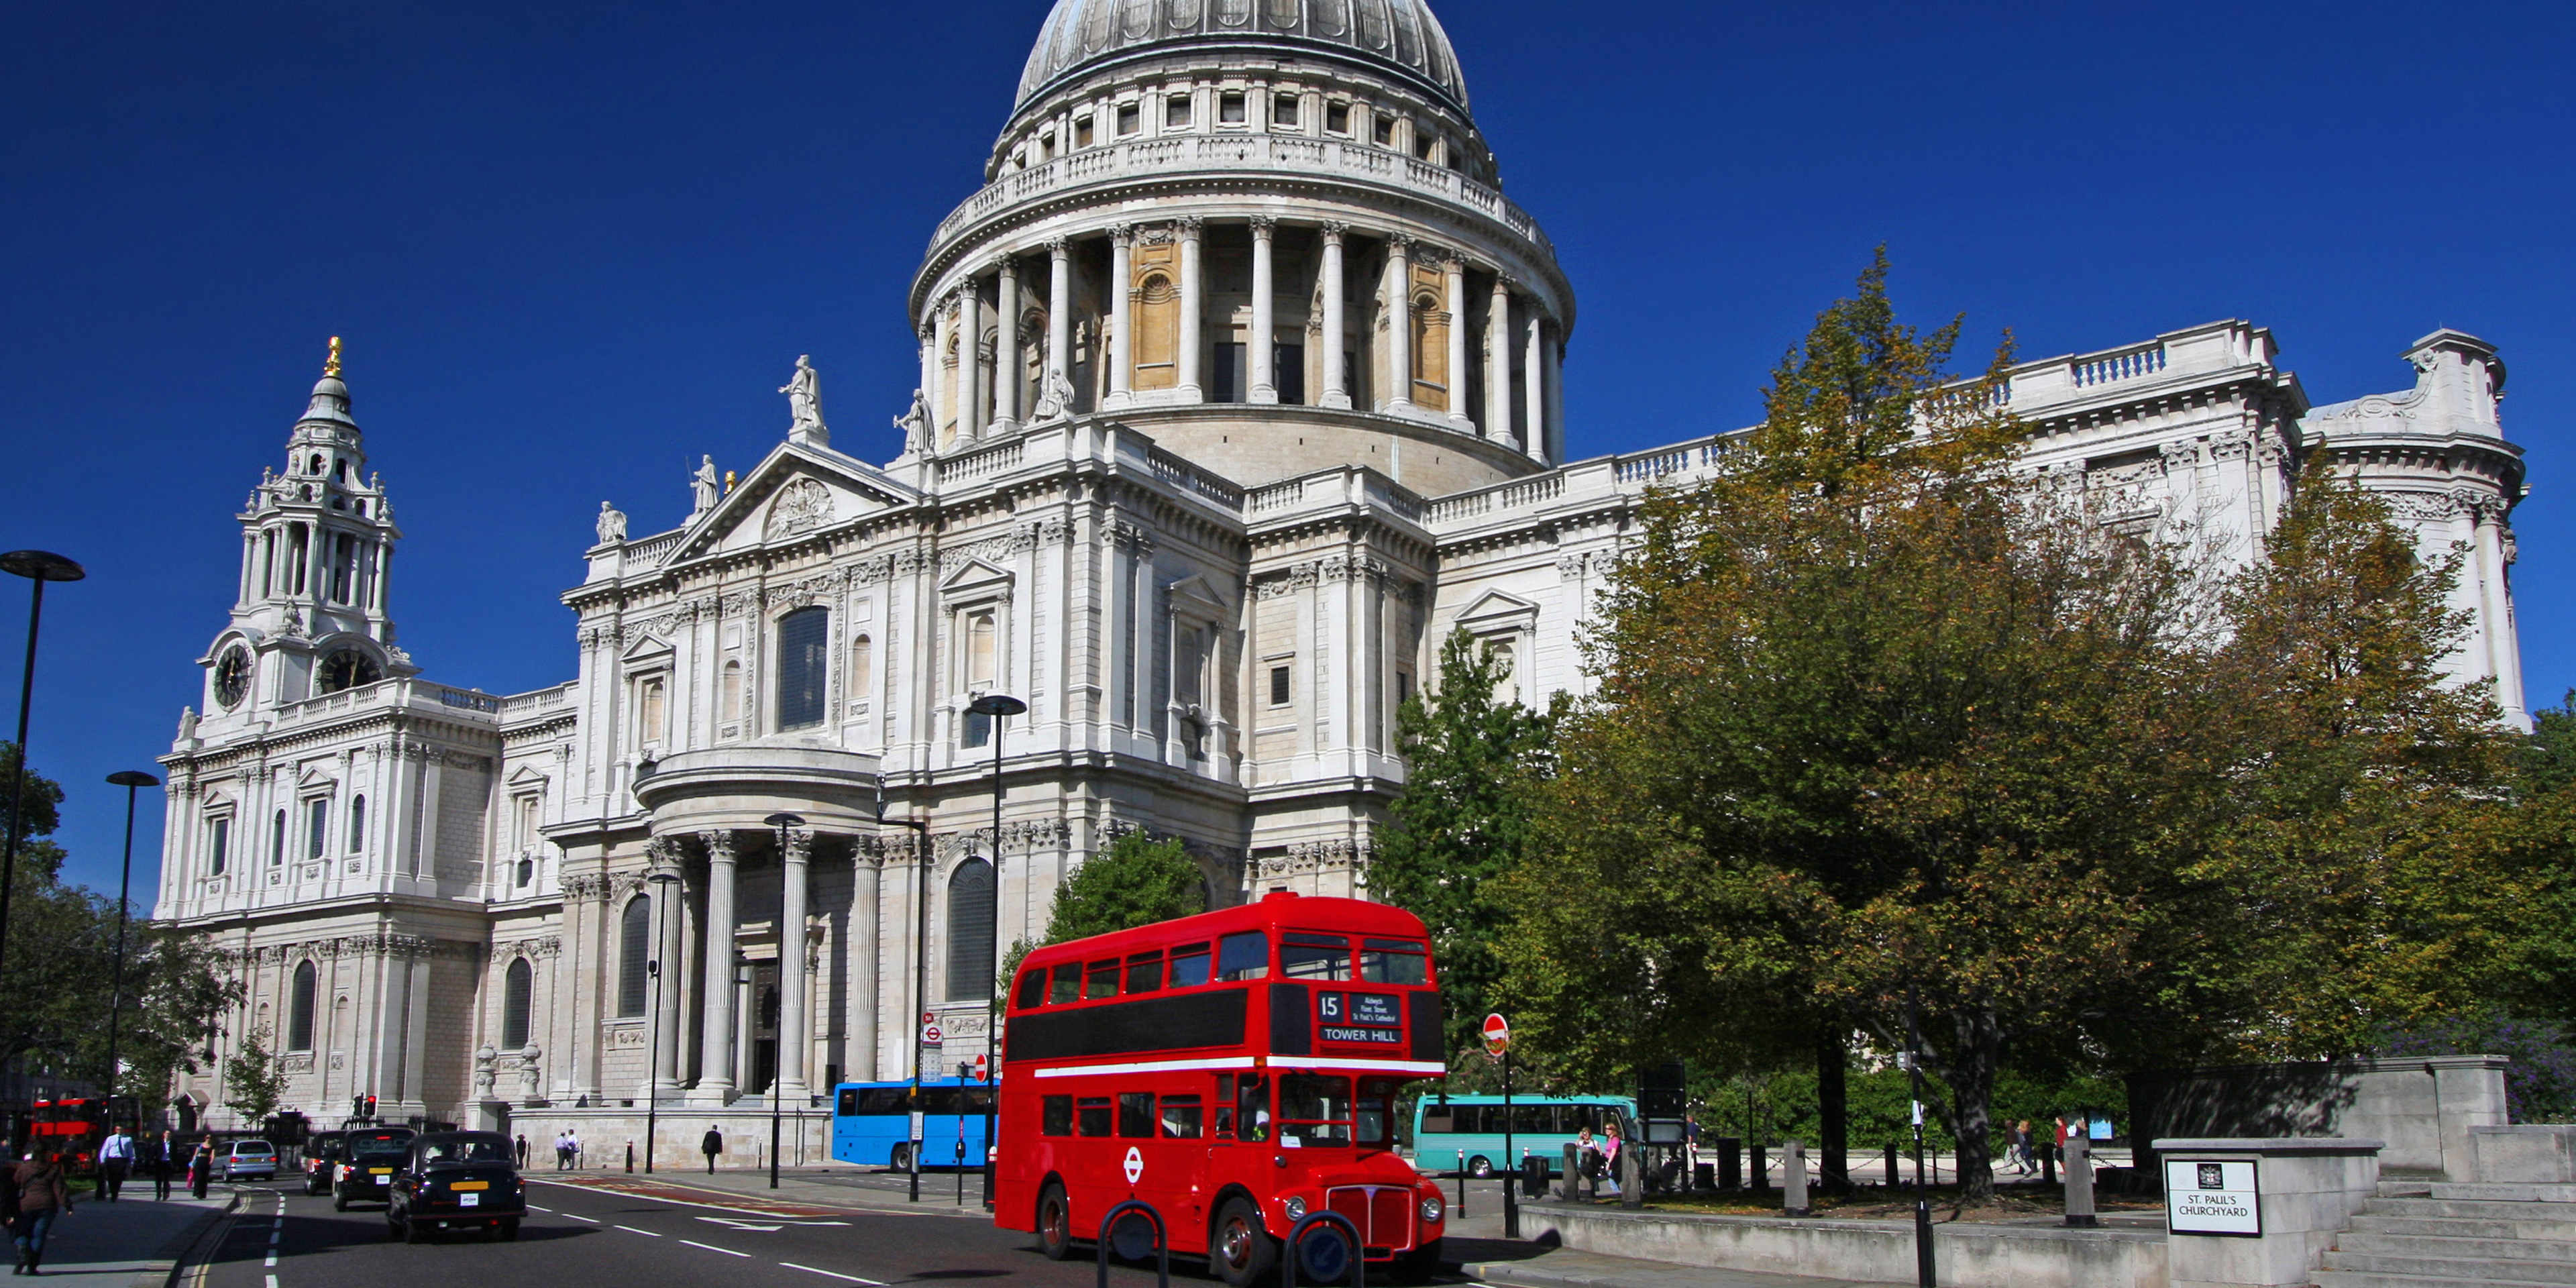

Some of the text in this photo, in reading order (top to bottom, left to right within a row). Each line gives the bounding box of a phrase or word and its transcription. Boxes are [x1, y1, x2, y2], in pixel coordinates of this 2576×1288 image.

[1322, 997, 1338, 1016] 15
[1325, 1029, 1396, 1042] TOWER HILL
[2188, 1195, 2237, 1205] ST. PAUL'S
[2179, 1206, 2248, 1216] CHURCHYARD
